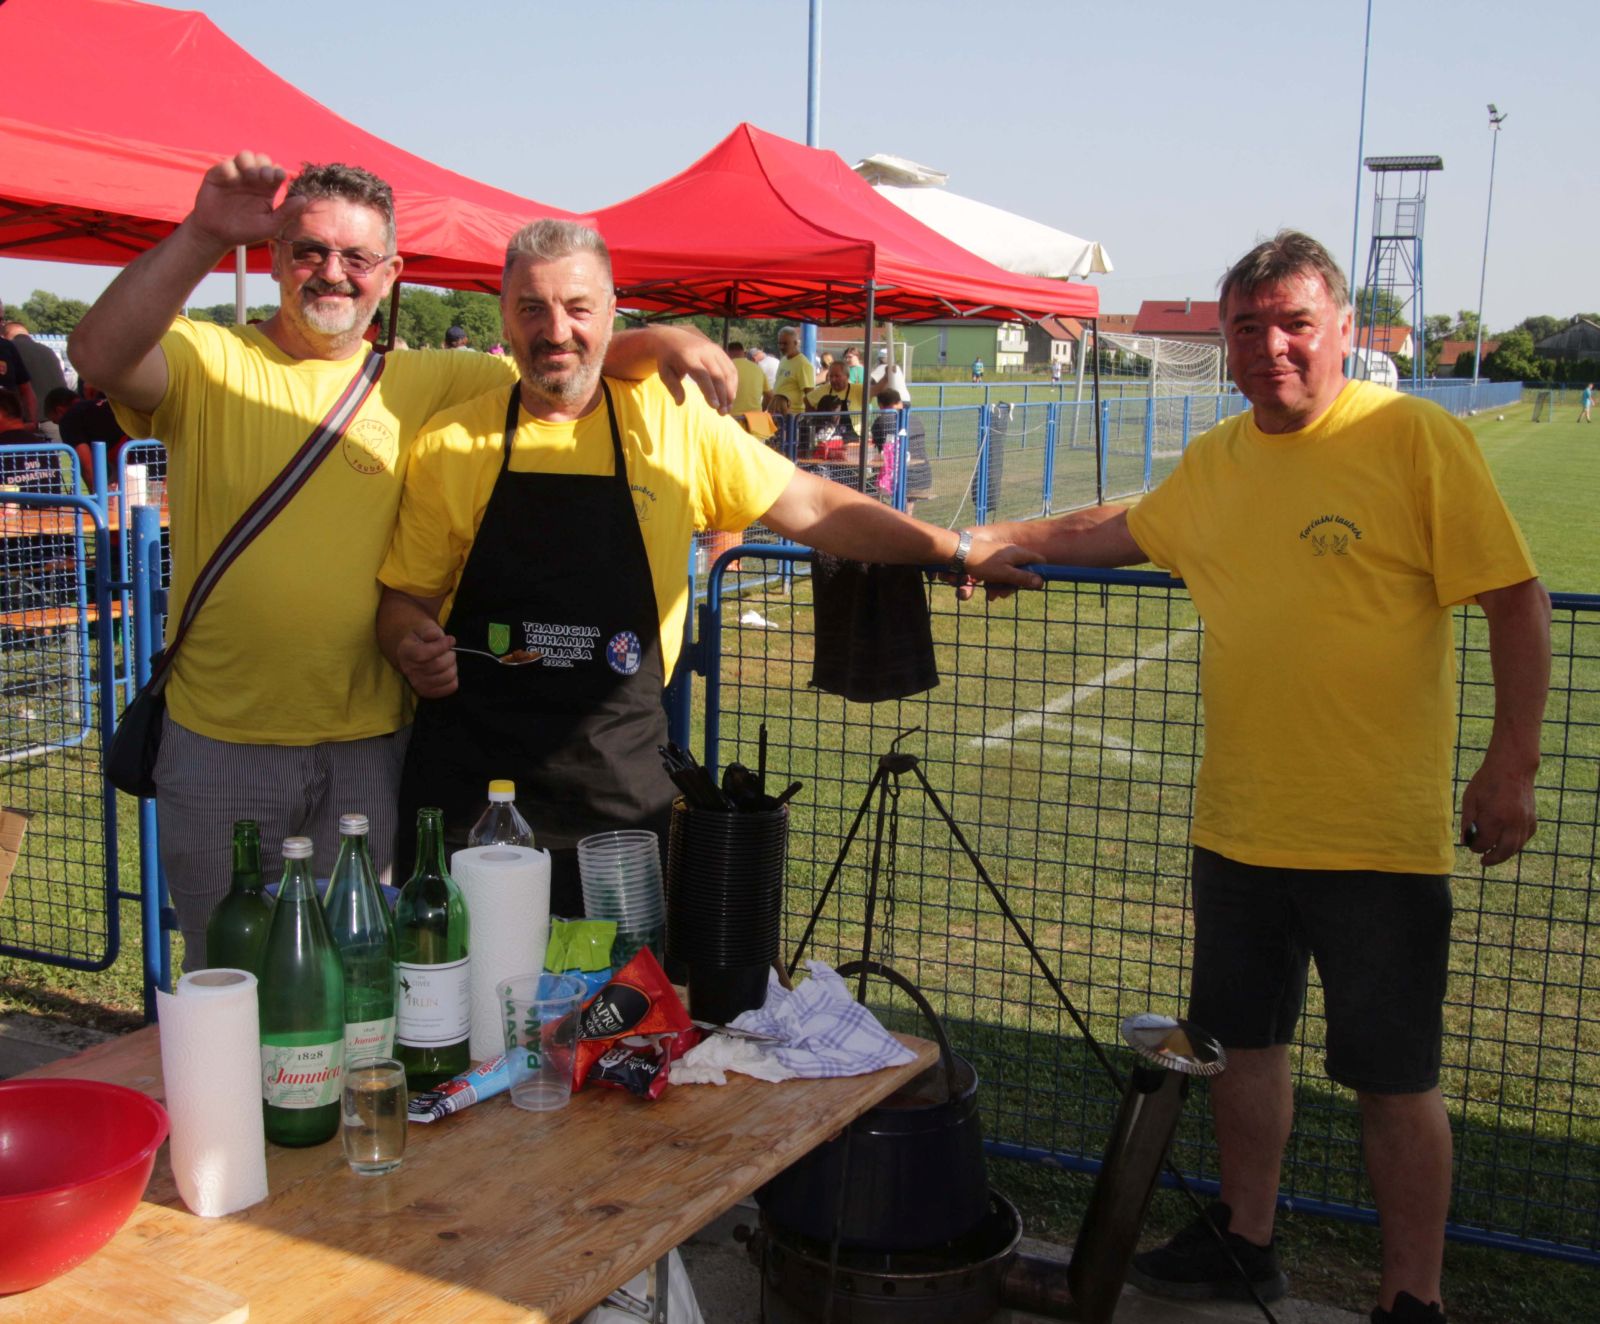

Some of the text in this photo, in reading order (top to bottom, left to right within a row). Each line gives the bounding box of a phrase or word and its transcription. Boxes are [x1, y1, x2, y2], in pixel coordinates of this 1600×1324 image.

[522, 621, 601, 637] TRADICIJA
[526, 633, 595, 648] KUHANJA
[525, 1019, 542, 1069] PAN
[298, 1050, 324, 1061] 1828
